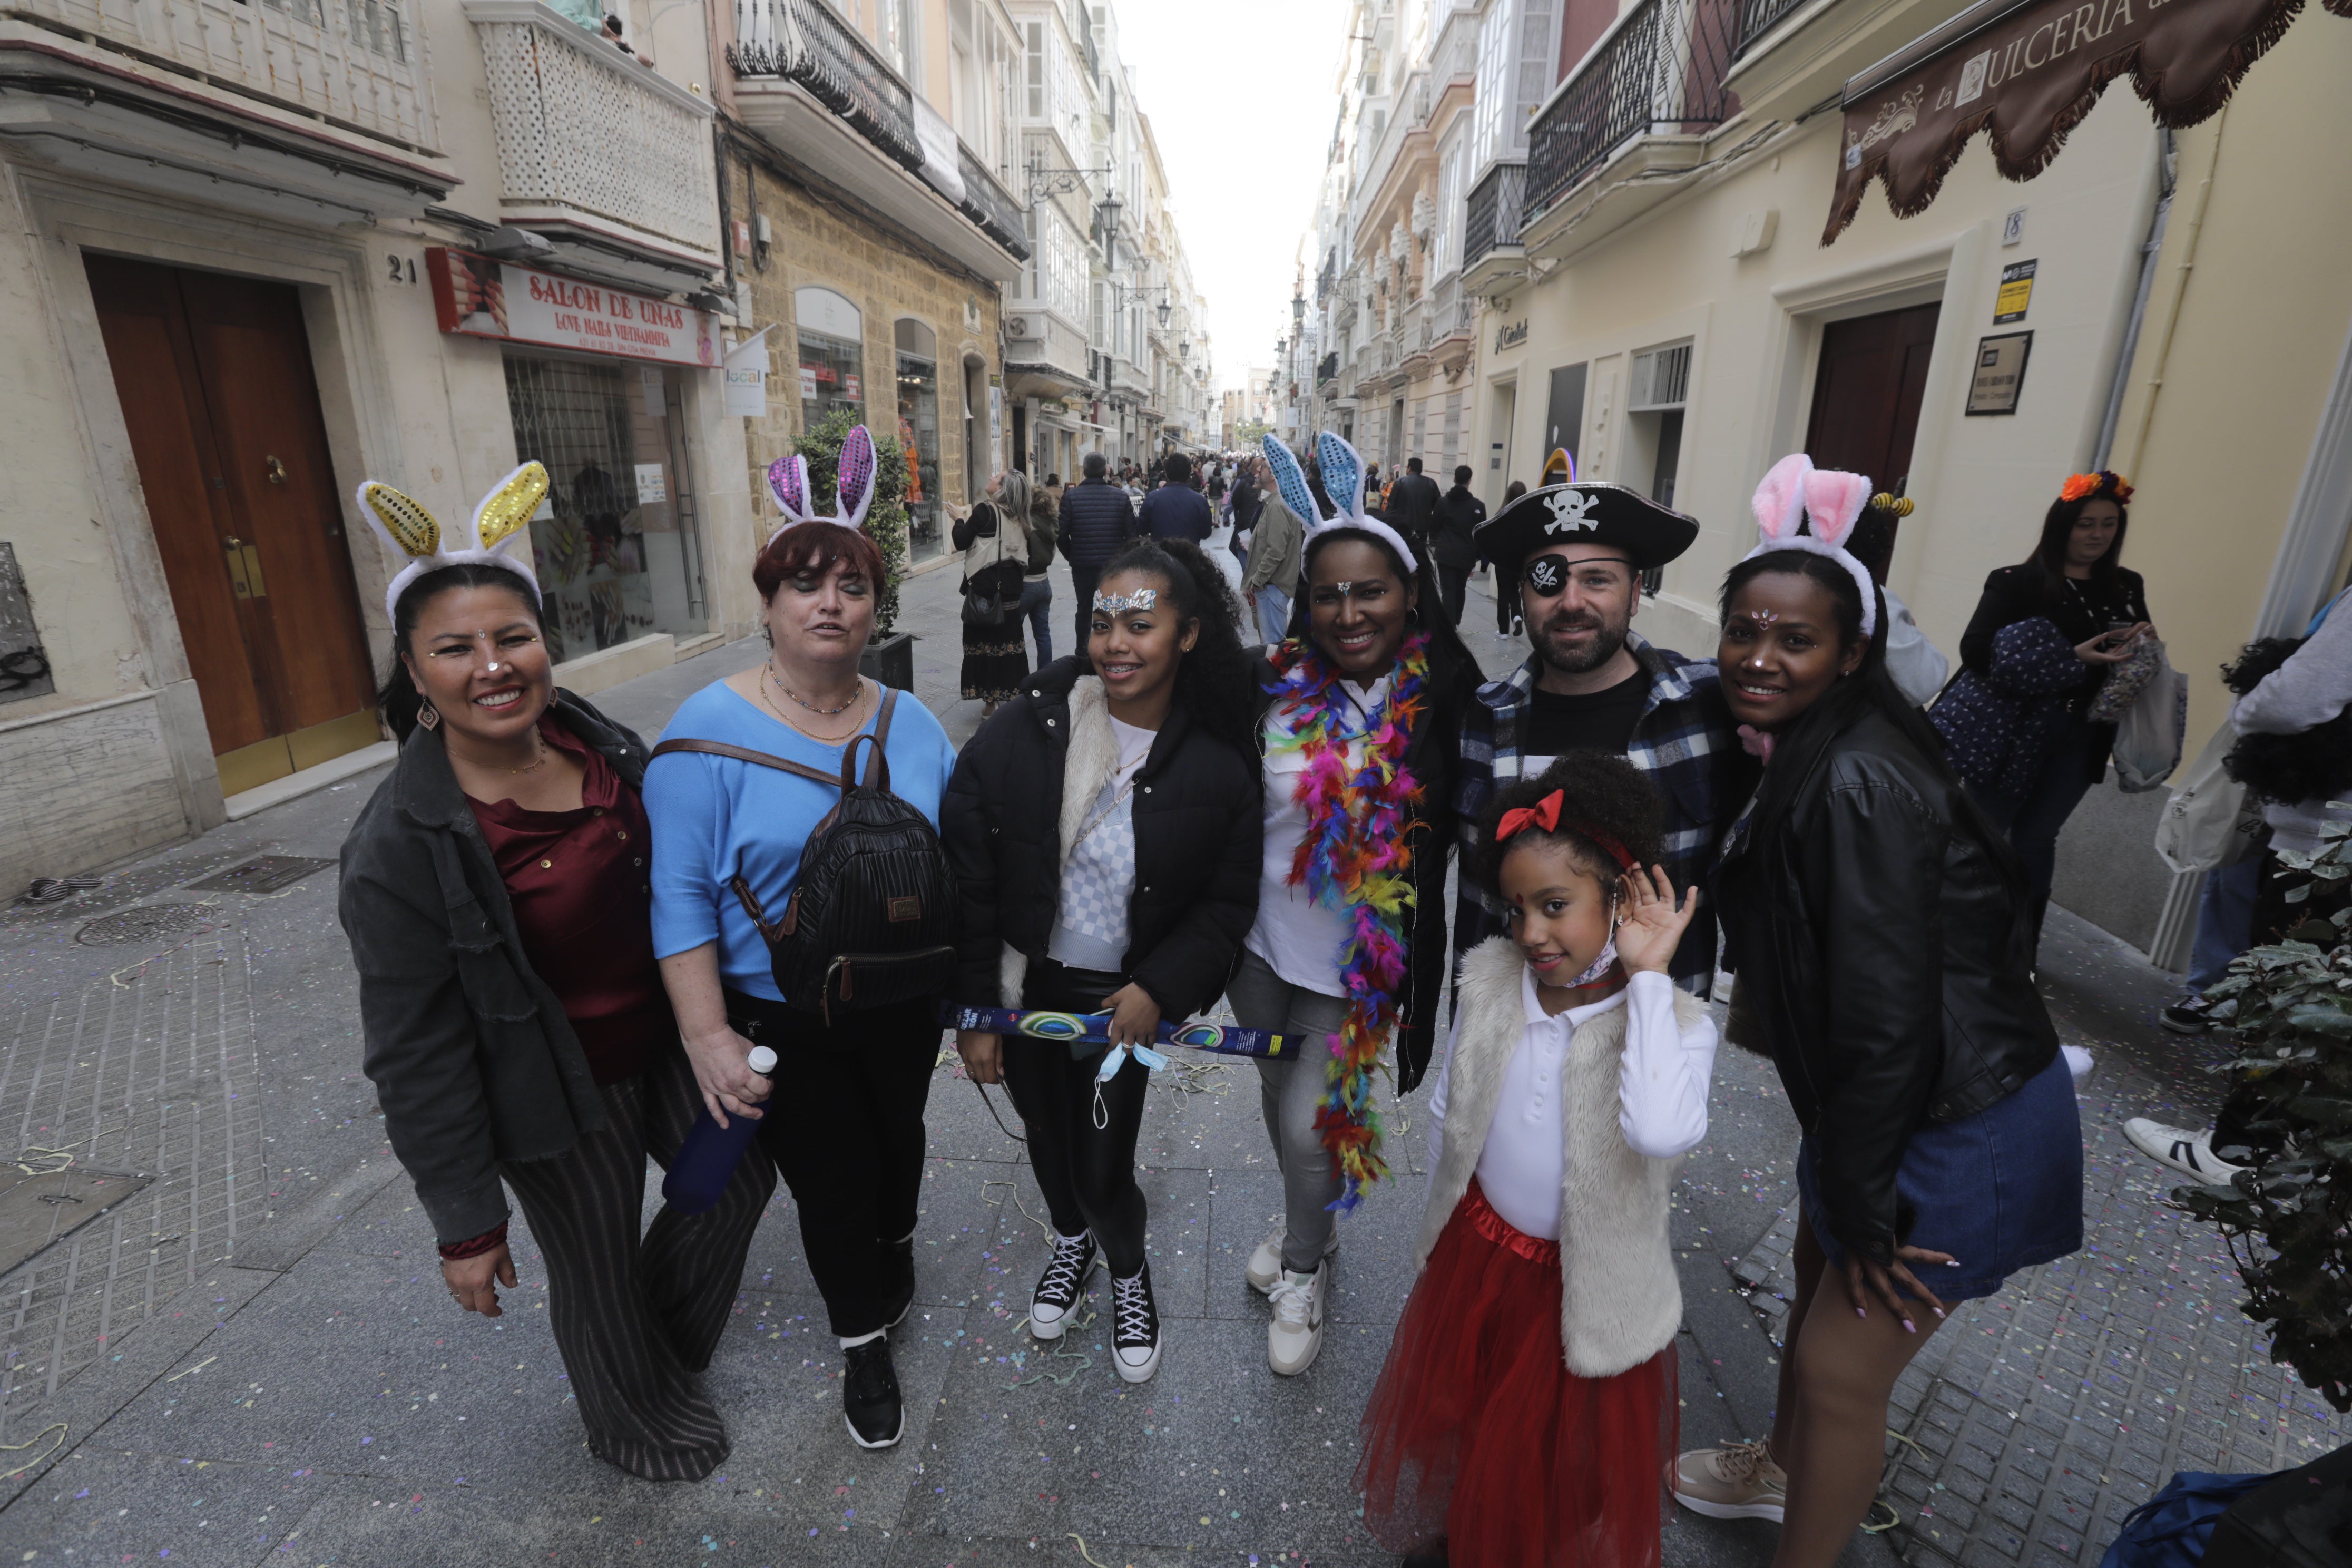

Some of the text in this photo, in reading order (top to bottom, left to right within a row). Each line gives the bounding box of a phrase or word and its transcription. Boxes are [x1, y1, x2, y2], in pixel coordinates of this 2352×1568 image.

[1935, 86, 1953, 112] La
[2004, 213, 2021, 238] 18
[387, 254, 417, 286] 21
[529, 275, 683, 329] SALON DE UÑAS
[555, 312, 581, 333] LOVE
[584, 317, 612, 338] NAILS
